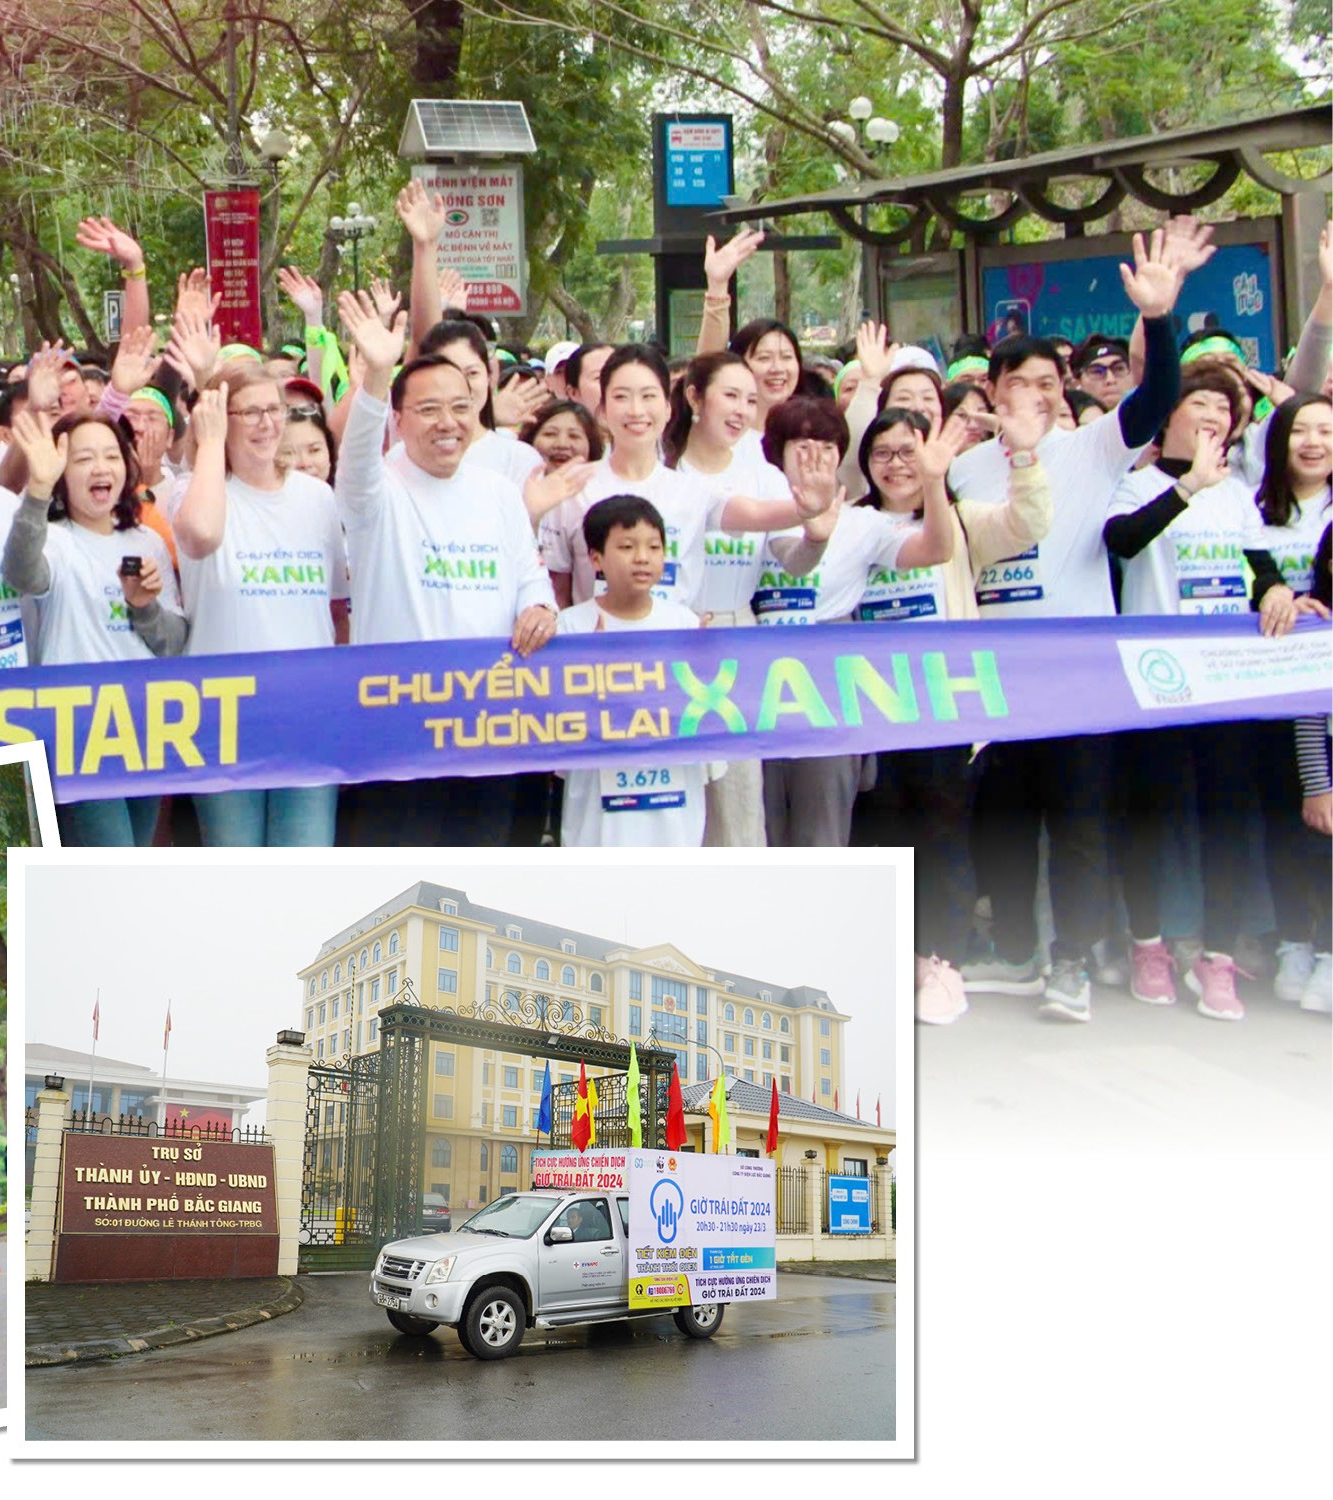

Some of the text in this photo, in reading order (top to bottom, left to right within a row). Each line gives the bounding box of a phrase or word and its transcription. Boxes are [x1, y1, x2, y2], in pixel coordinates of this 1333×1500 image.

[478, 194, 505, 207] SƠN
[704, 538, 755, 557] ANH
[241, 564, 325, 584] XANH
[423, 554, 497, 579] XANH
[870, 565, 933, 586] ANH
[981, 565, 1034, 584] 22.666
[759, 571, 821, 588] ANH
[358, 653, 666, 707] CHUYỂN DỊCH
[672, 650, 1009, 738] XANH
[424, 707, 671, 750] TƯƠNG LAI
[616, 768, 671, 788] 3.678
[152, 1143, 203, 1164] TRỤ SỞ
[610, 1156, 626, 1170] DỊCH
[75, 1162, 133, 1184] THÀNH
[139, 1164, 162, 1186] ỦY
[175, 1171, 217, 1188] HĐND
[228, 1174, 267, 1189] UBND
[535, 1169, 623, 1188] GIỜ TRÁI ĐẤT 2024
[84, 1193, 262, 1214] THÀNH PHỐ BẮC GIANG
[690, 1196, 771, 1216] GIỜ TRÁI ĐẤT 2024
[124, 1216, 160, 1228] ĐƯỜNG
[163, 1217, 175, 1228] LÊ
[177, 1216, 209, 1228] THÁNH
[696, 1221, 716, 1232] 20h30
[720, 1221, 738, 1232] 21h30
[739, 1223, 753, 1234] ngày
[754, 1222, 766, 1232] 23/3
[636, 1245, 698, 1260] TIẾT KIỆM ĐIỆN
[702, 1285, 766, 1299] GIỜ TRÁI ĐẤT 2024
